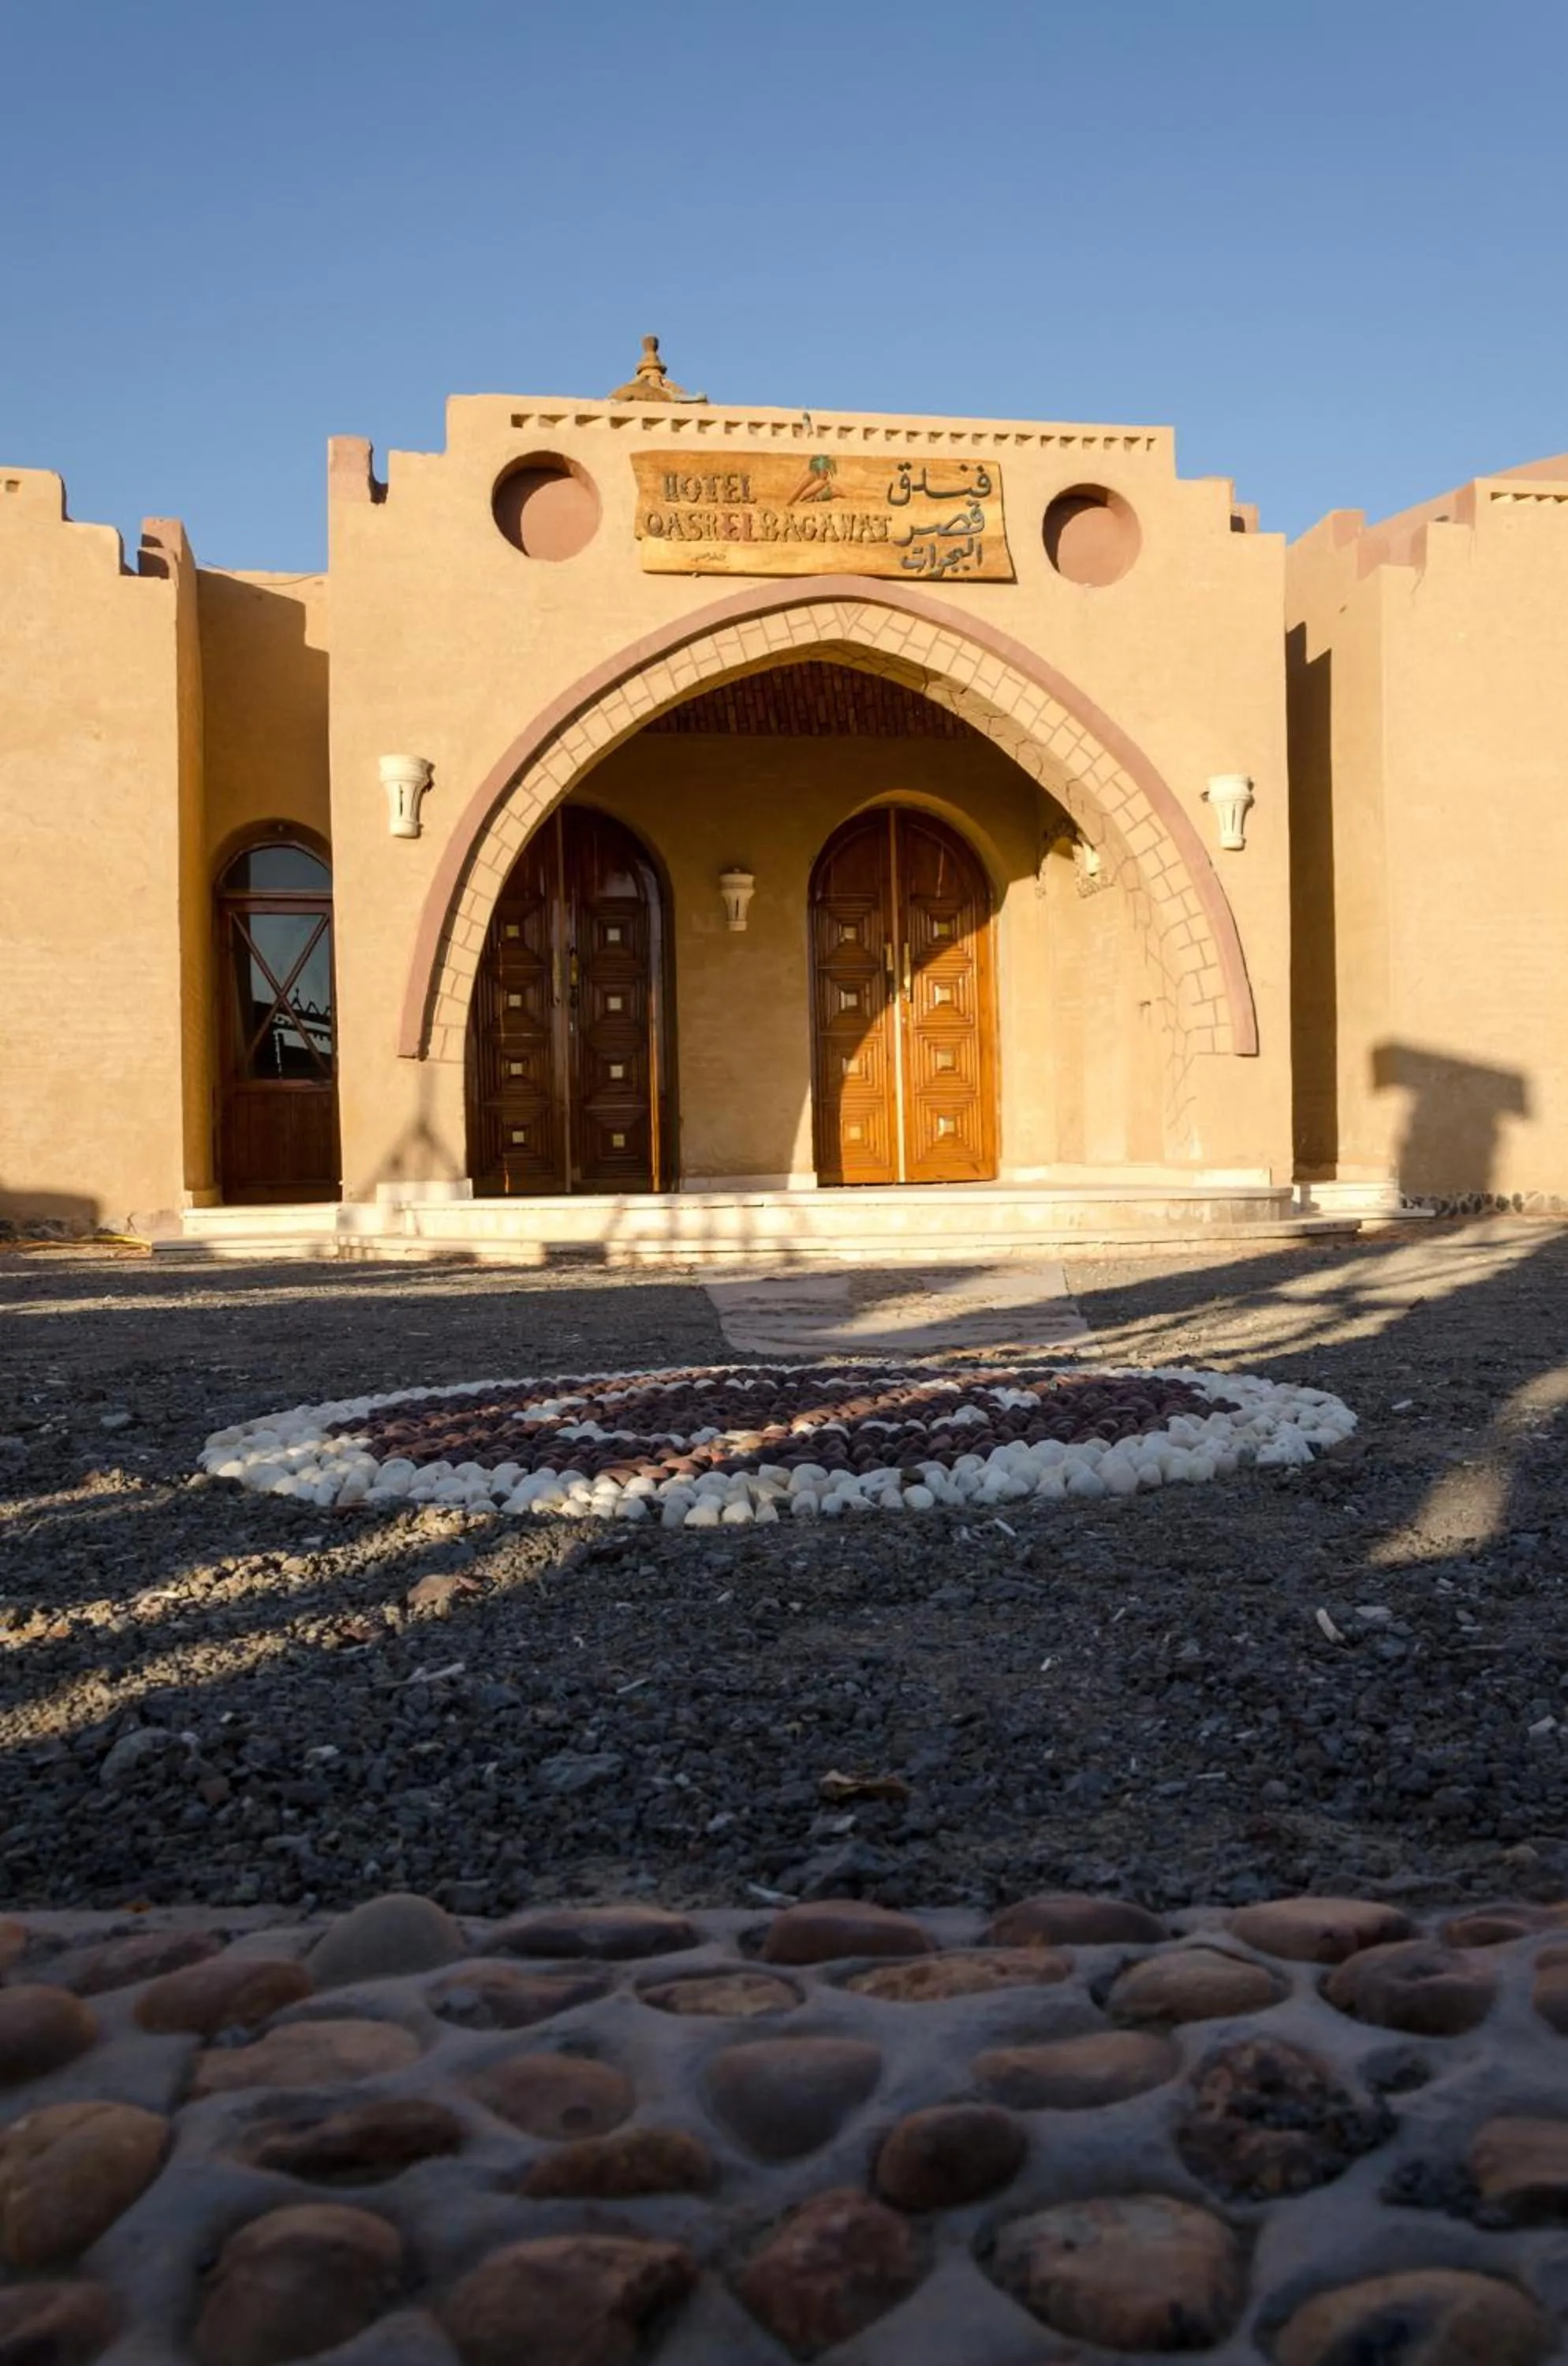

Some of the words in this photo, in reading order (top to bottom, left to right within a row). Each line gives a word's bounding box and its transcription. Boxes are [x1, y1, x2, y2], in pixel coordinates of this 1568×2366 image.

[663, 472, 758, 503] HOTEL
[887, 462, 992, 506] فندق
[893, 500, 985, 547] قصر
